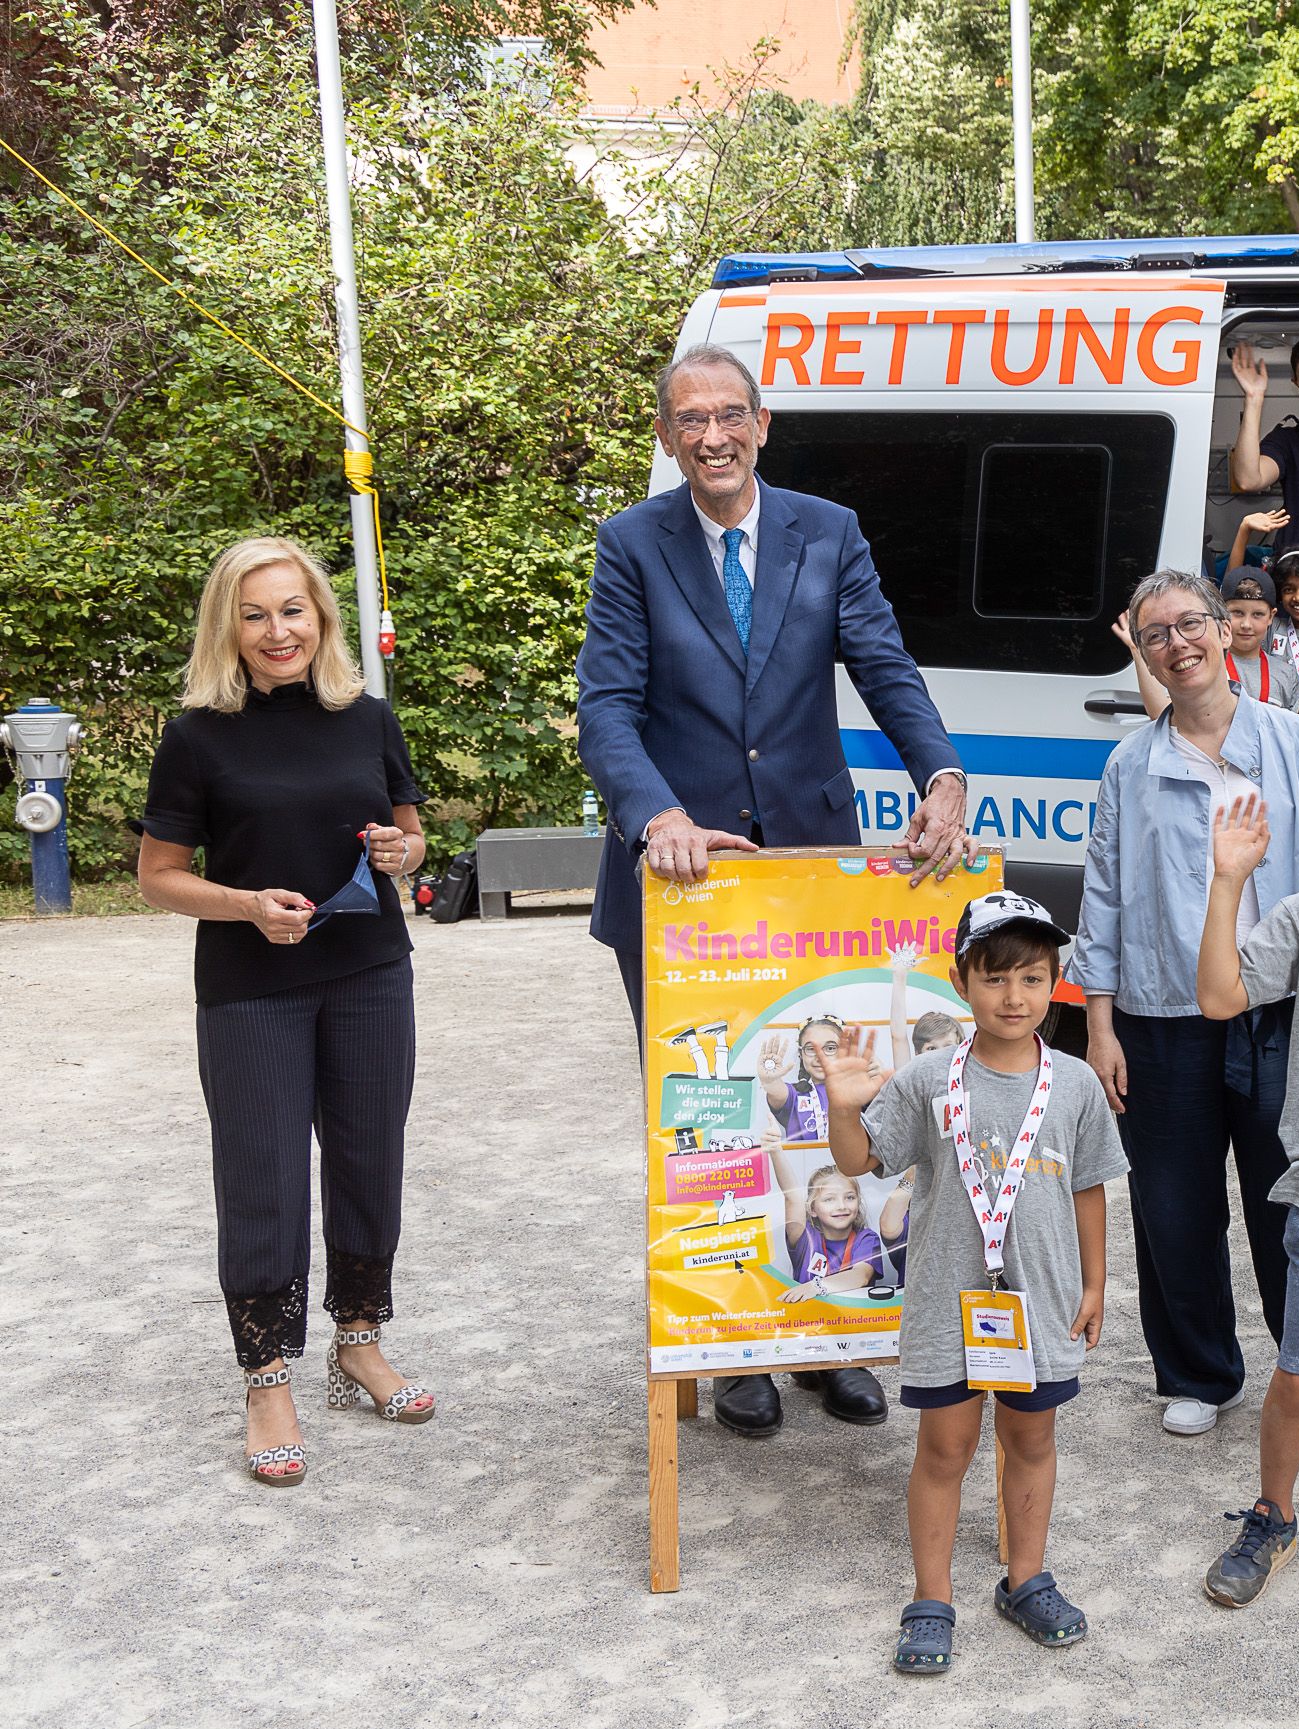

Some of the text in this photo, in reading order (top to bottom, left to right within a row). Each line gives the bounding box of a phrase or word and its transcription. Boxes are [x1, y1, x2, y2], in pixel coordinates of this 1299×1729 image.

[761, 306, 1203, 387] RETTUNG
[1272, 638, 1284, 650] A1
[684, 875, 740, 893] kinderuni
[686, 892, 713, 903] wien
[664, 916, 957, 961] KinderuniWie
[665, 971, 686, 983] 12.
[699, 970, 721, 982] 23.
[724, 968, 750, 981] Juli
[753, 968, 787, 981] 2021
[675, 1085, 734, 1095] Wir stellen
[951, 1077, 960, 1091] A1
[1039, 1081, 1050, 1091] A1
[682, 1098, 742, 1109] die Uni auf
[953, 1103, 963, 1117] A1
[674, 1111, 695, 1121] den
[1030, 1106, 1044, 1116] A1
[957, 1131, 966, 1144] A1
[1020, 1132, 1034, 1142] A1
[675, 1158, 752, 1173] Informationen
[963, 1158, 972, 1172] A1
[1010, 1158, 1024, 1168] A1
[676, 1167, 754, 1184] 0800 220 120
[972, 1183, 982, 1197] A1
[1002, 1184, 1016, 1195] A1
[993, 1211, 1008, 1222] A1
[679, 1227, 757, 1251] Neugierig?
[988, 1239, 1001, 1248] A1
[692, 1251, 750, 1265] kinderuni.at
[812, 1258, 827, 1272] A1
[667, 1308, 785, 1324] Tipp zum Weiterforschen!
[717, 1325, 727, 1334] zu
[728, 1322, 751, 1335] jeder
[754, 1321, 771, 1330] Zeit
[774, 1319, 791, 1329] und
[793, 1317, 825, 1328] überall
[826, 1316, 841, 1325] auf
